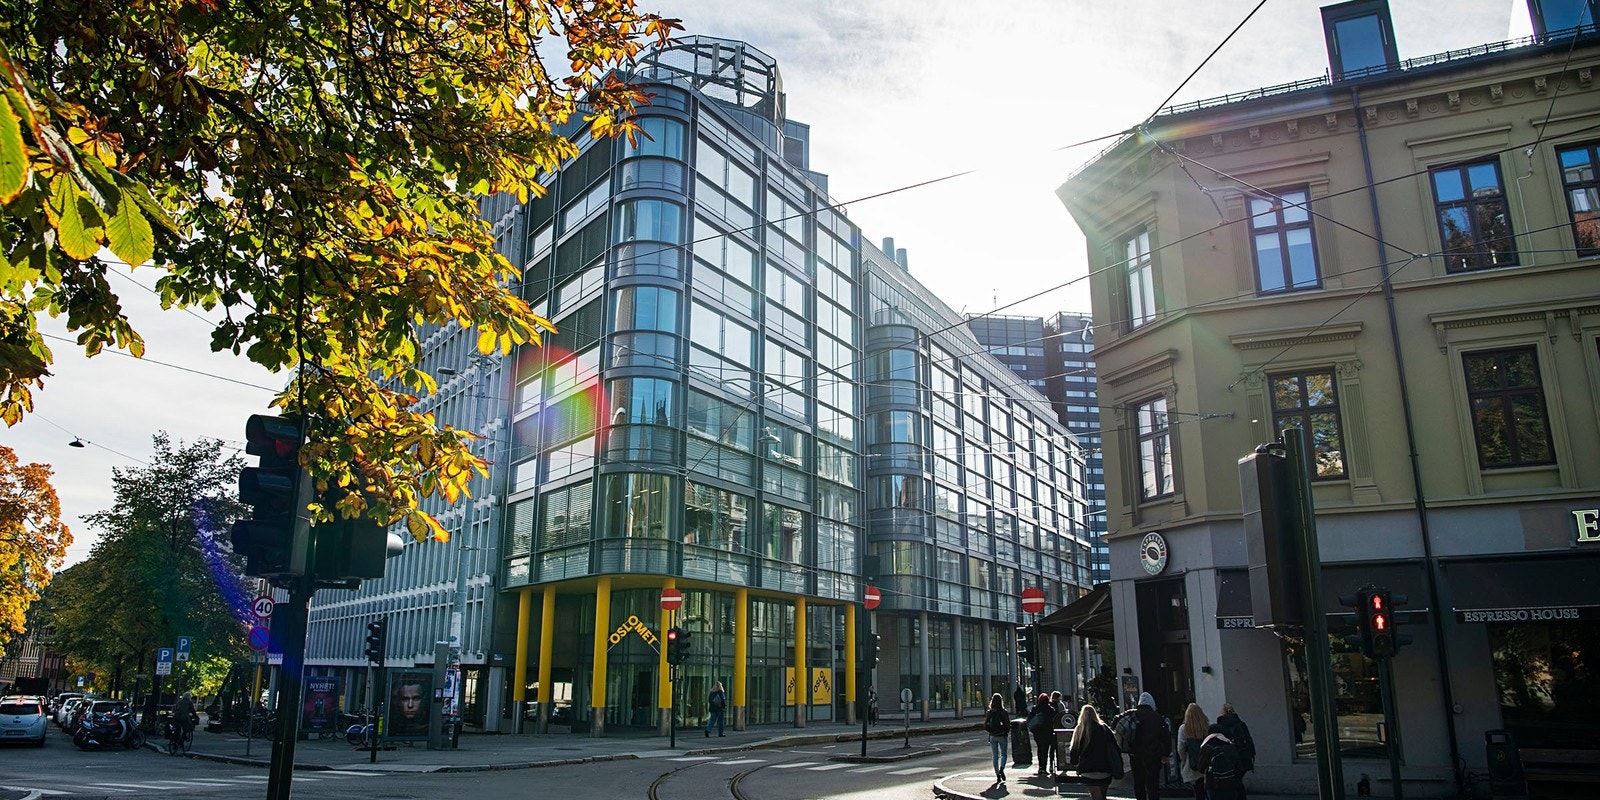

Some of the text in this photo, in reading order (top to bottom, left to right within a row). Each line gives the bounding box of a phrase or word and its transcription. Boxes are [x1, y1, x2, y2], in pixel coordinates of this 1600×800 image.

[256, 602, 273, 614] 40
[1463, 608, 1580, 622] ESPRESSO HOUSE
[610, 615, 658, 645] OSLOMET
[813, 670, 831, 693] OSLOMET
